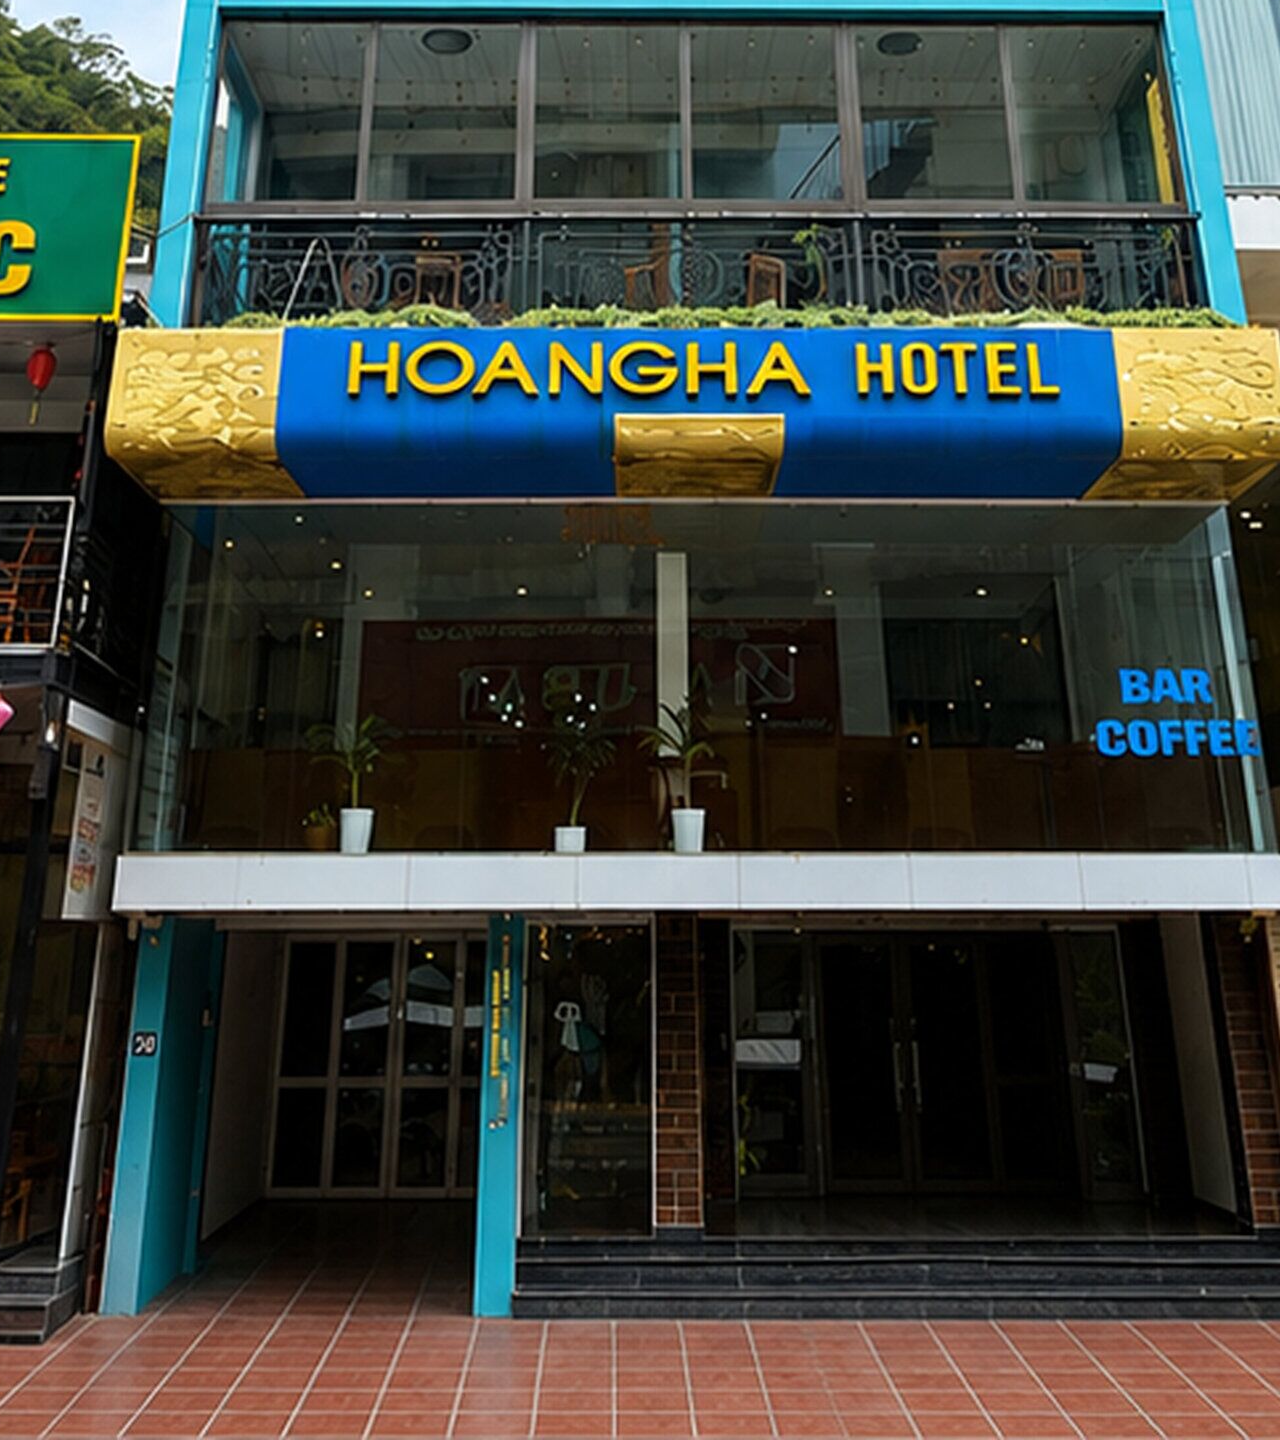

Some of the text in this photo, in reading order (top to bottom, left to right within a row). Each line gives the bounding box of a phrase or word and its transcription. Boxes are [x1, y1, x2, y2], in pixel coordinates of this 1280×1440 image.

[347, 341, 1062, 396] HOANGHA HOTEL
[1119, 667, 1215, 705] BAR
[1094, 718, 1261, 758] COFFEE
